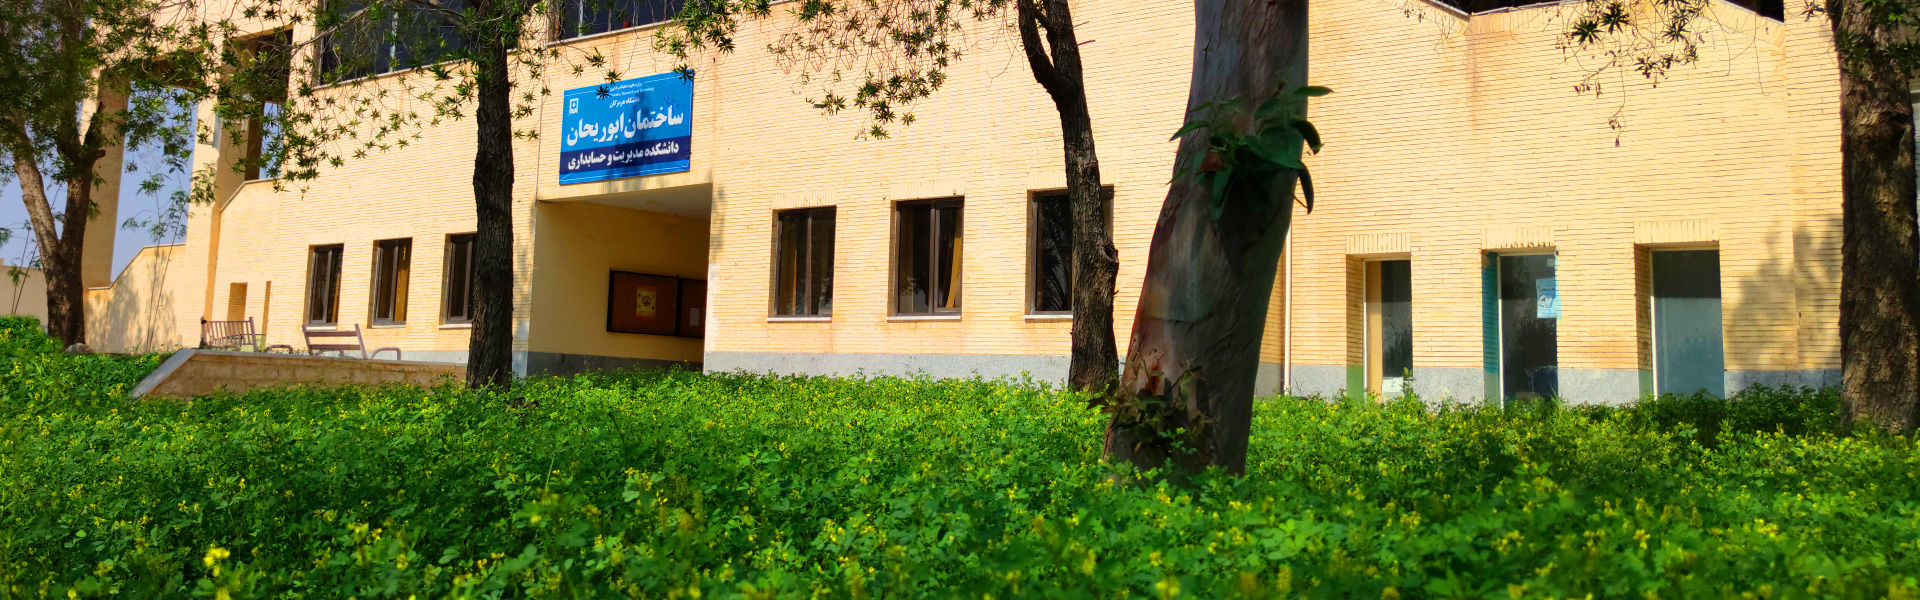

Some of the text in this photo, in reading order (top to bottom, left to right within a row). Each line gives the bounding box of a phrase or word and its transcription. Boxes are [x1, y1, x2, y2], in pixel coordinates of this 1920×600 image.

[567, 105, 683, 146] ساختمان ابوریحان
[567, 141, 679, 170] دانشکده مدیریت و حسابداری
